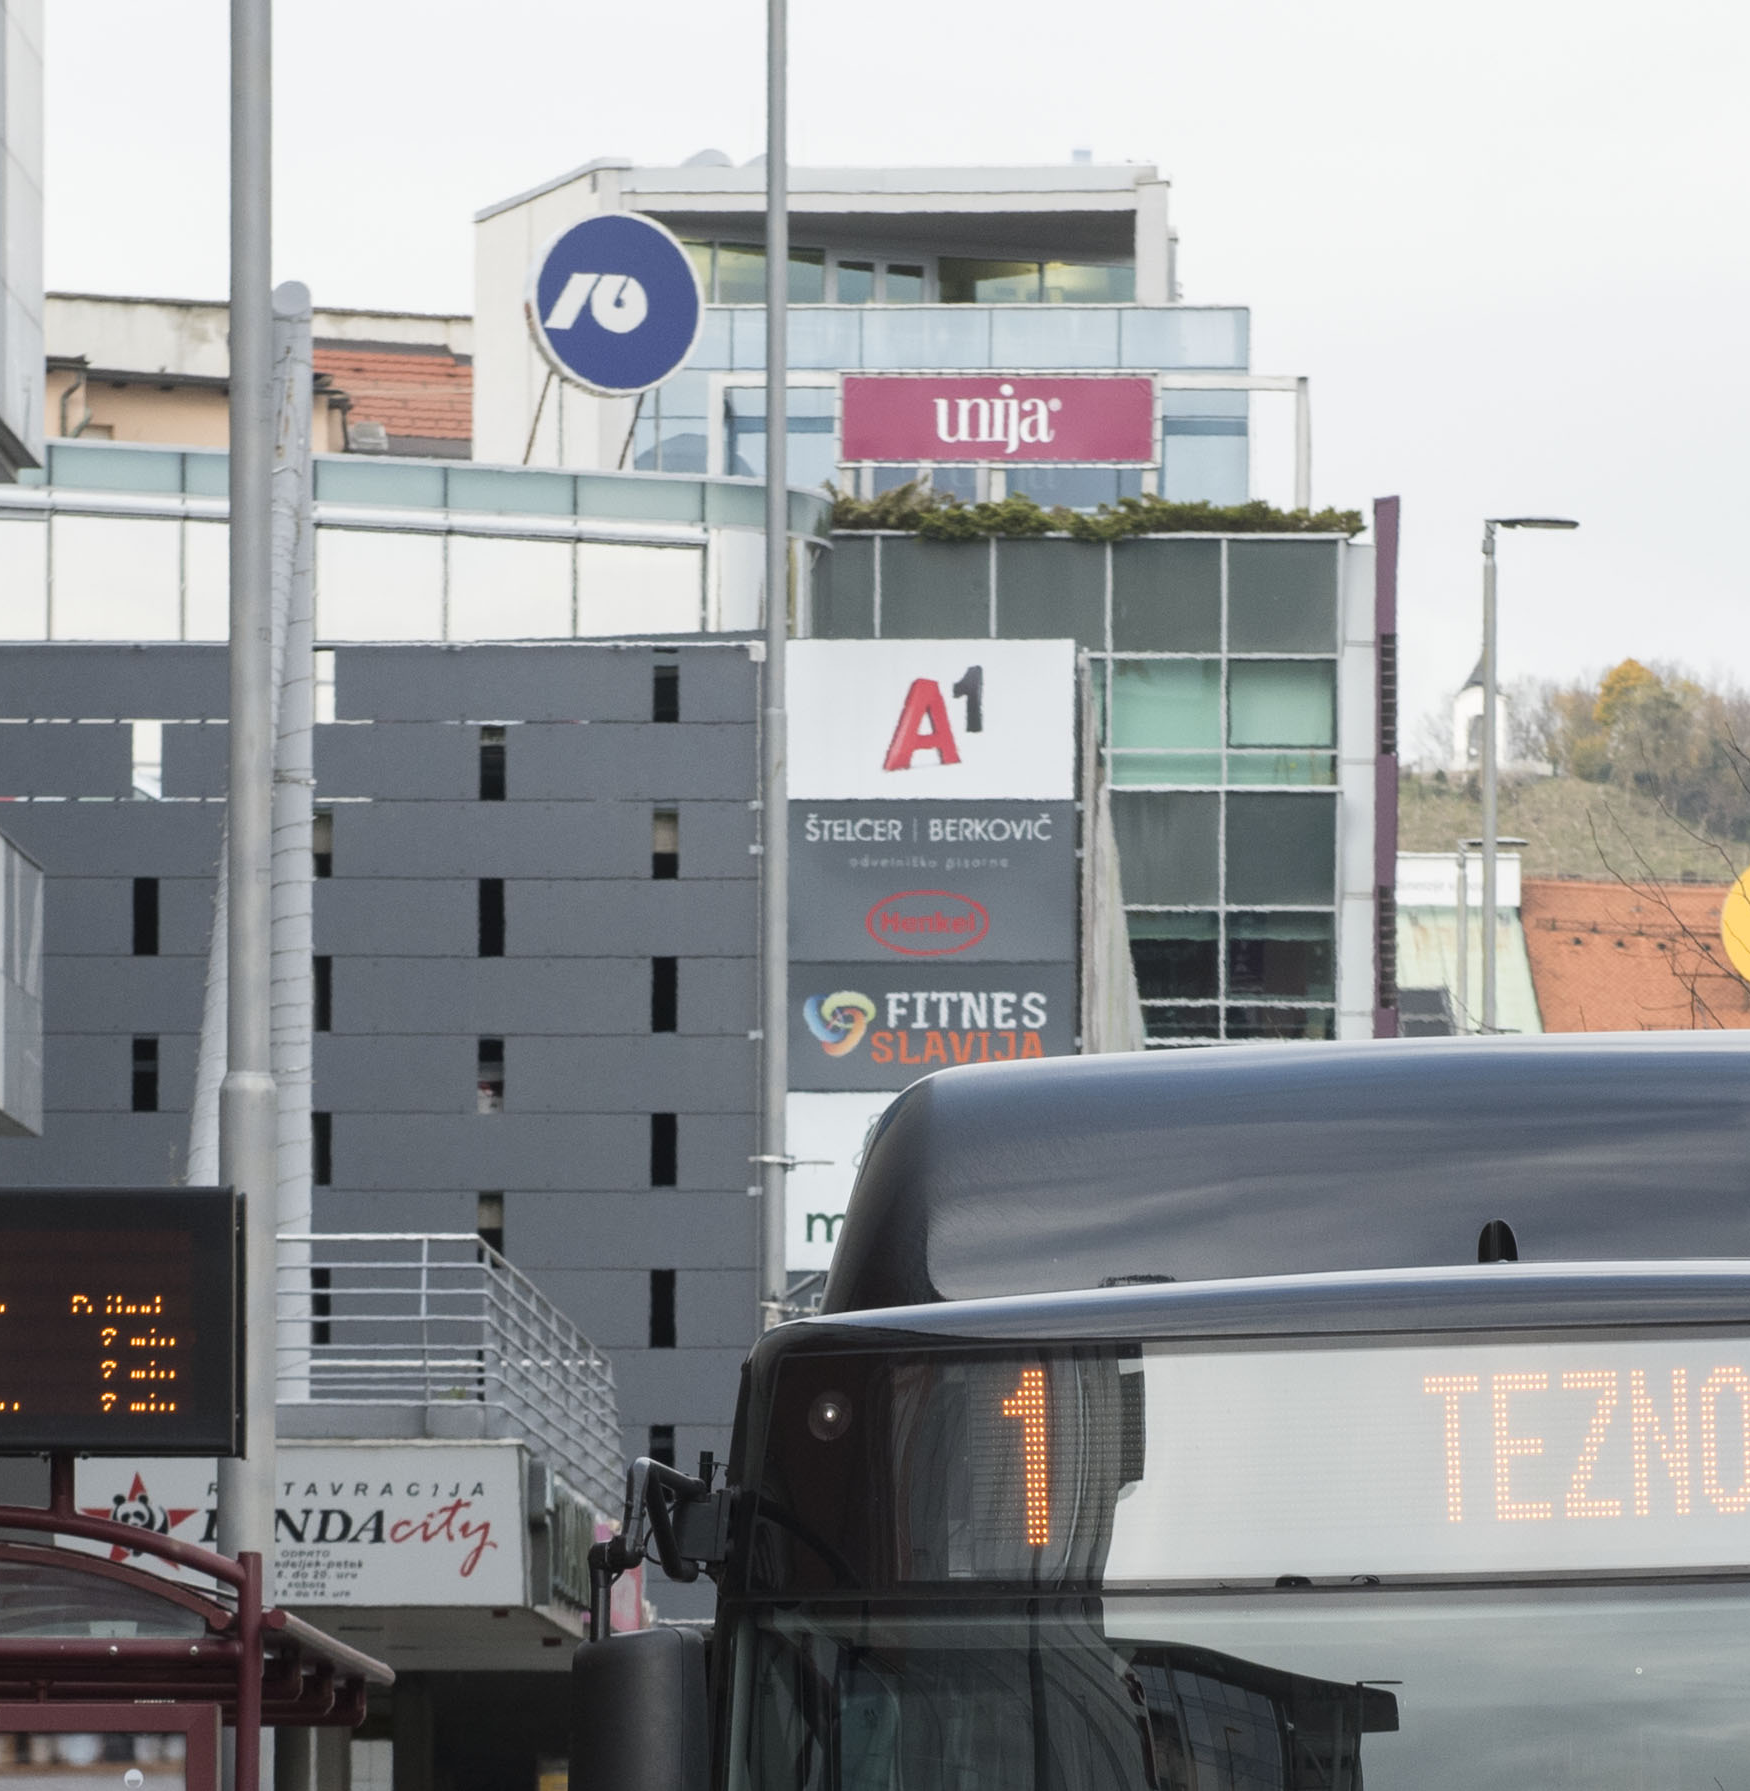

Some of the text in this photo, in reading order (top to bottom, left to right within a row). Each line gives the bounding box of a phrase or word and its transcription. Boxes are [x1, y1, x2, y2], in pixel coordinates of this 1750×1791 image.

[935, 385, 1056, 454] unija
[882, 665, 984, 772] A1
[804, 813, 1053, 842] ŠTELCER BERKOVIČ
[880, 911, 976, 934] Henkel
[885, 991, 1048, 1030] FITNES
[871, 1030, 1045, 1066] SLAVIJA
[1002, 1369, 1050, 1546] 1
[207, 1481, 485, 1497] RTAVRACIJA
